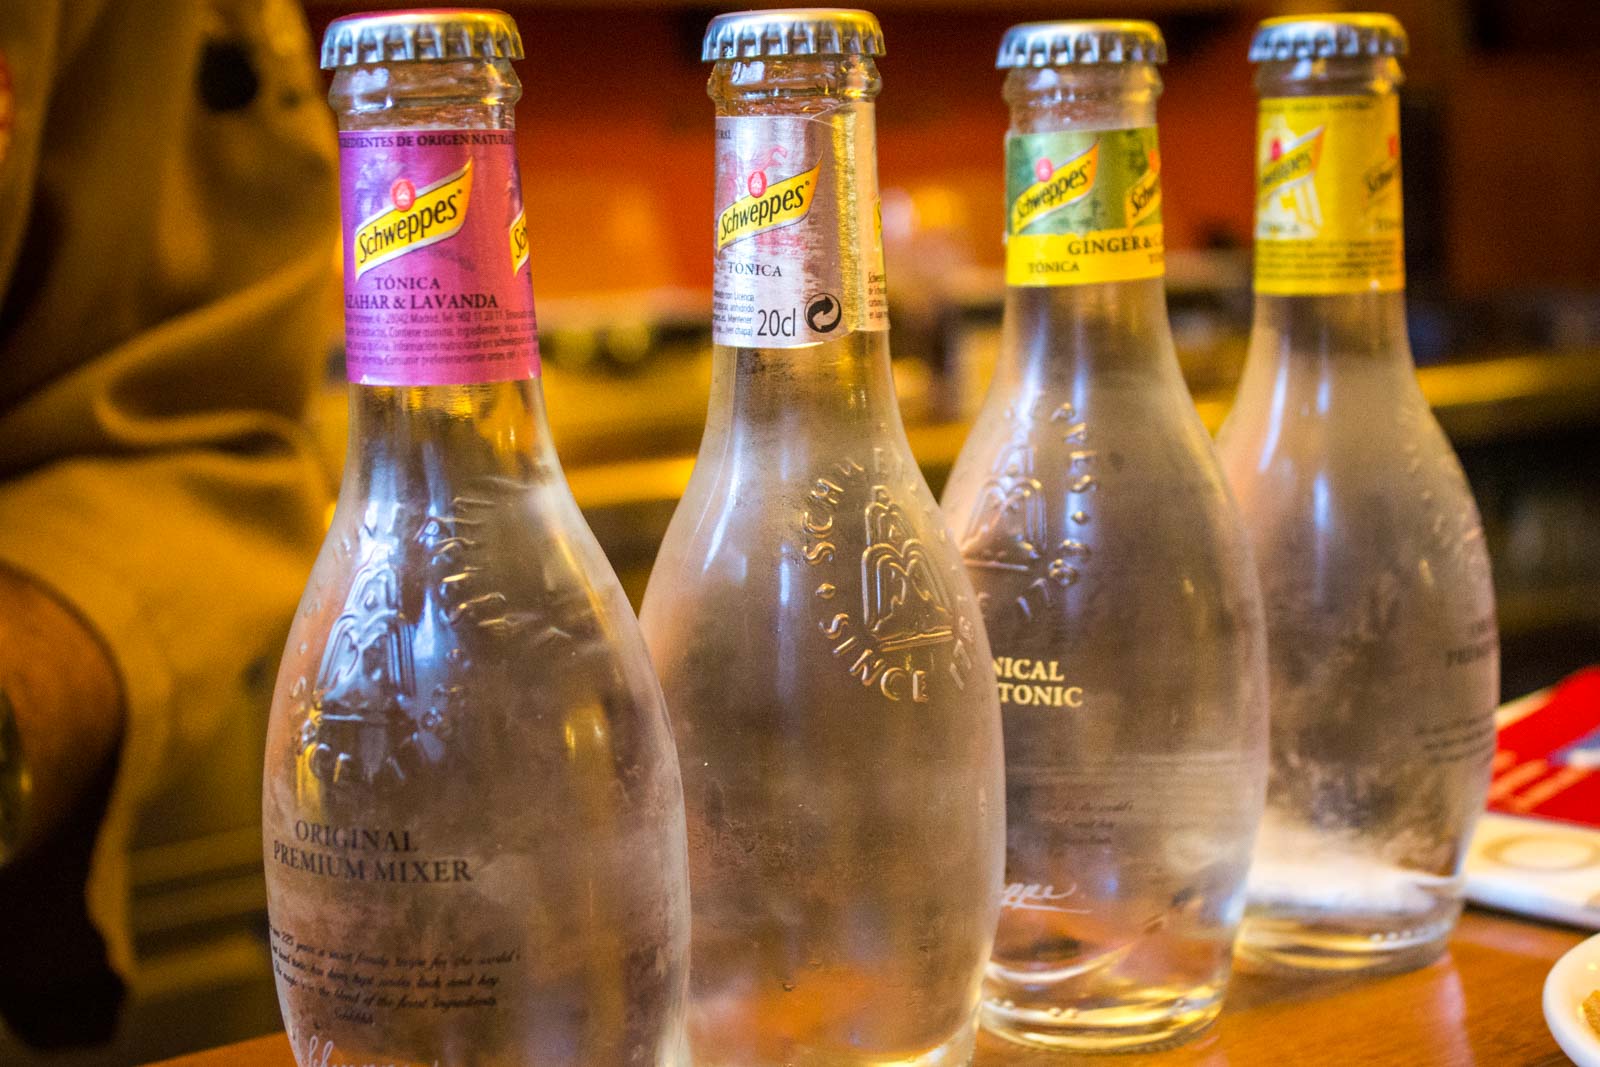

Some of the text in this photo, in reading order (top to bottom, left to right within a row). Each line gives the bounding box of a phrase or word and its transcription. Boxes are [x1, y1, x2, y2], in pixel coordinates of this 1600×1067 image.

[396, 135, 414, 148] DE
[416, 133, 470, 147] ORIGEN
[720, 184, 805, 241] Schweppes
[358, 193, 458, 263] Schweppes
[1067, 235, 1142, 255] GINGER
[374, 273, 440, 290] TÓNICA
[392, 295, 406, 310] &
[411, 293, 499, 310] LAVANDA
[757, 308, 796, 337] 20cl
[997, 682, 1084, 708] TONIC
[294, 819, 420, 853] ORIGINAL
[273, 839, 474, 884] PREMIUM MIXER
